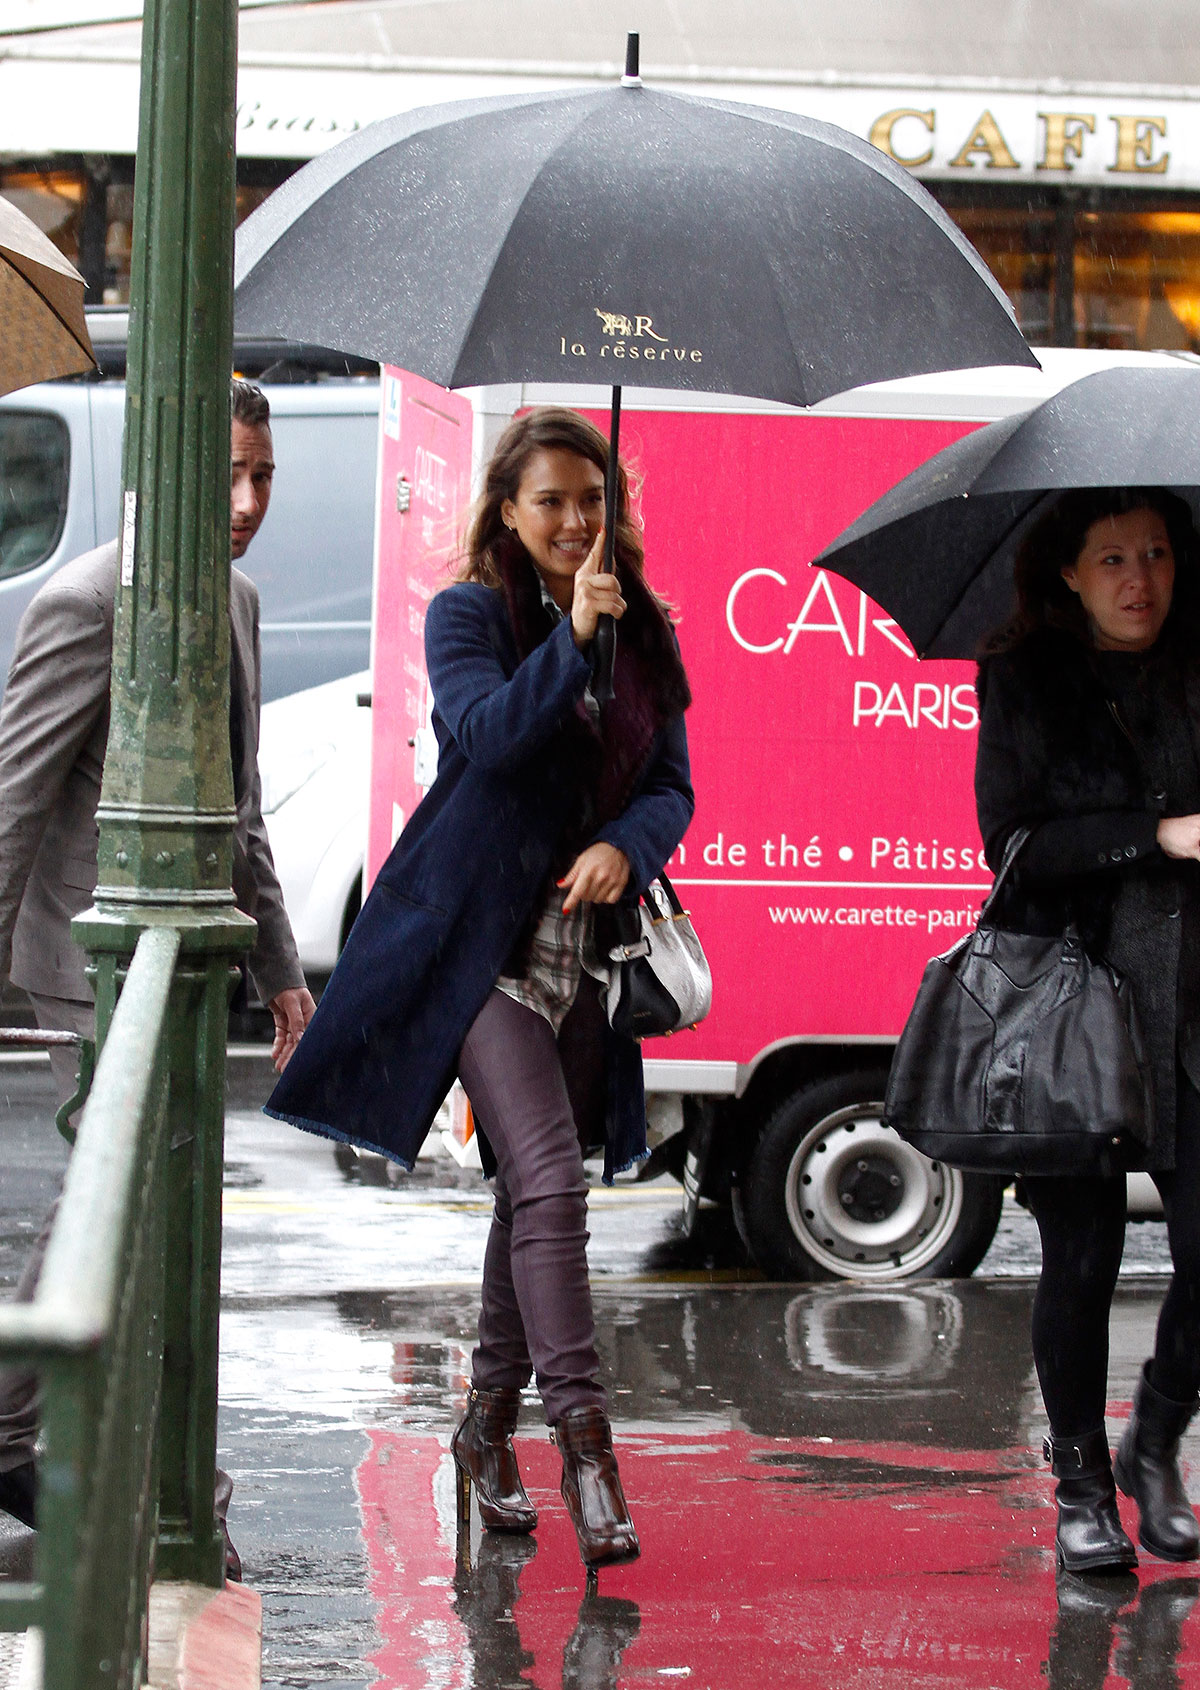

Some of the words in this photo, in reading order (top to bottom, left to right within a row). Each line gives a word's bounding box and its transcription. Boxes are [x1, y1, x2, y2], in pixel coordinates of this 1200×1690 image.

[868, 107, 1170, 174] CAFE
[559, 337, 587, 356] la
[600, 340, 703, 363] réserve
[853, 680, 980, 731] PARIS
[703, 832, 746, 866] de
[762, 833, 822, 868] thé
[768, 904, 982, 935] www.carette-paris
